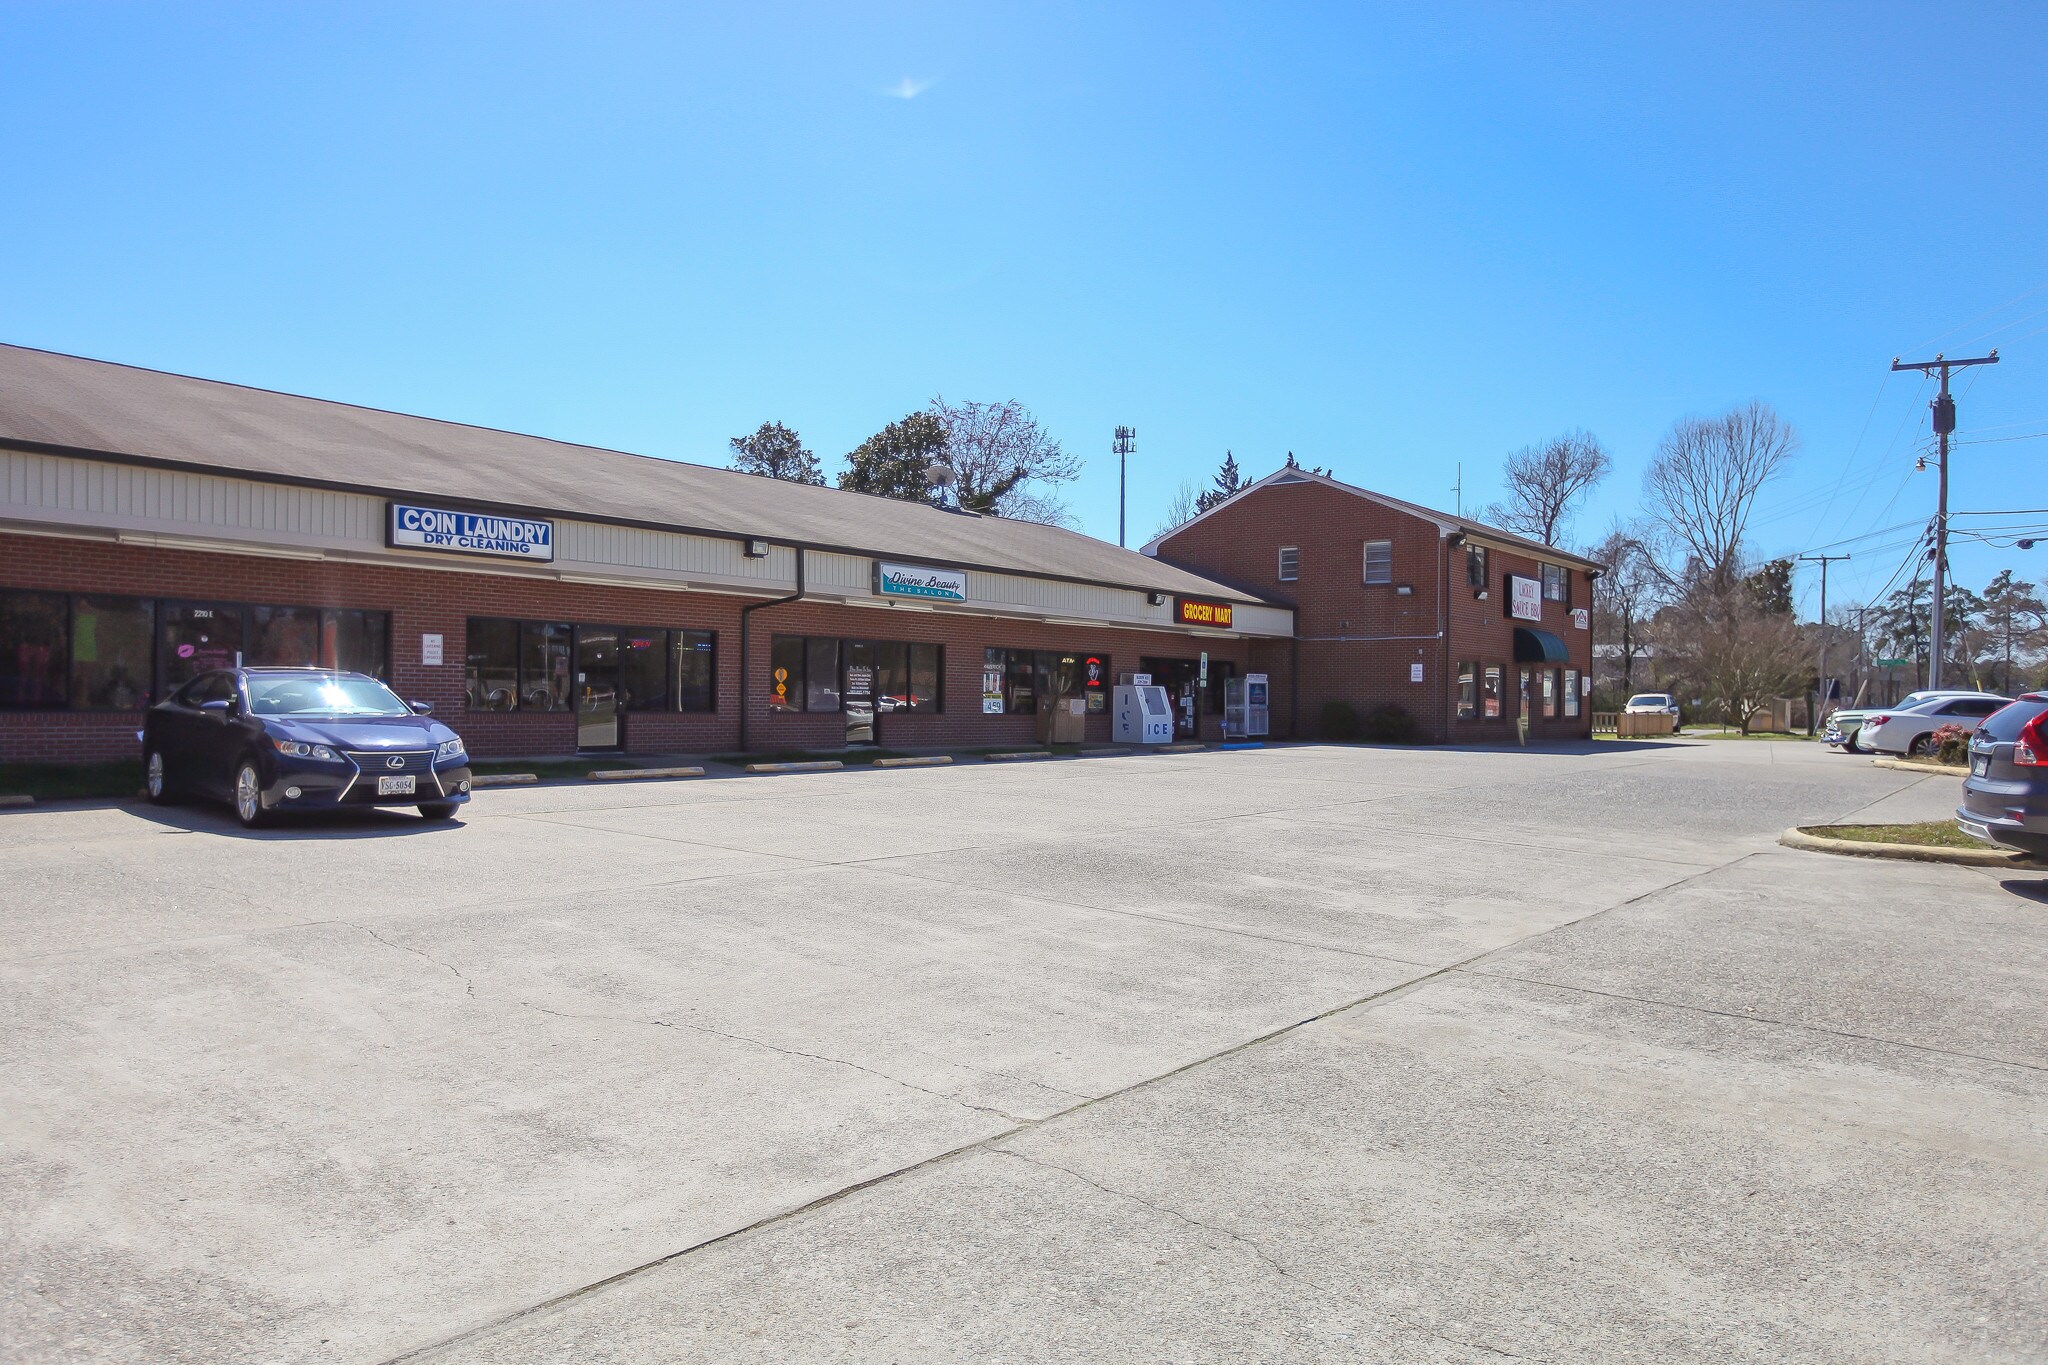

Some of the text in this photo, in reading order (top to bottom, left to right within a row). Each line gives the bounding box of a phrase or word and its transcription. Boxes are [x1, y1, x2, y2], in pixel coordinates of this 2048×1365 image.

[403, 509, 547, 544] COIN LAUNDRY
[424, 533, 530, 553] DRY CLEANING
[888, 571, 960, 597] Divine Beauty
[893, 585, 950, 597] THE SALON
[1184, 603, 1231, 623] GROCERY MART
[1512, 600, 1541, 621] SAUCE BBQ
[1147, 723, 1167, 735] ICE
